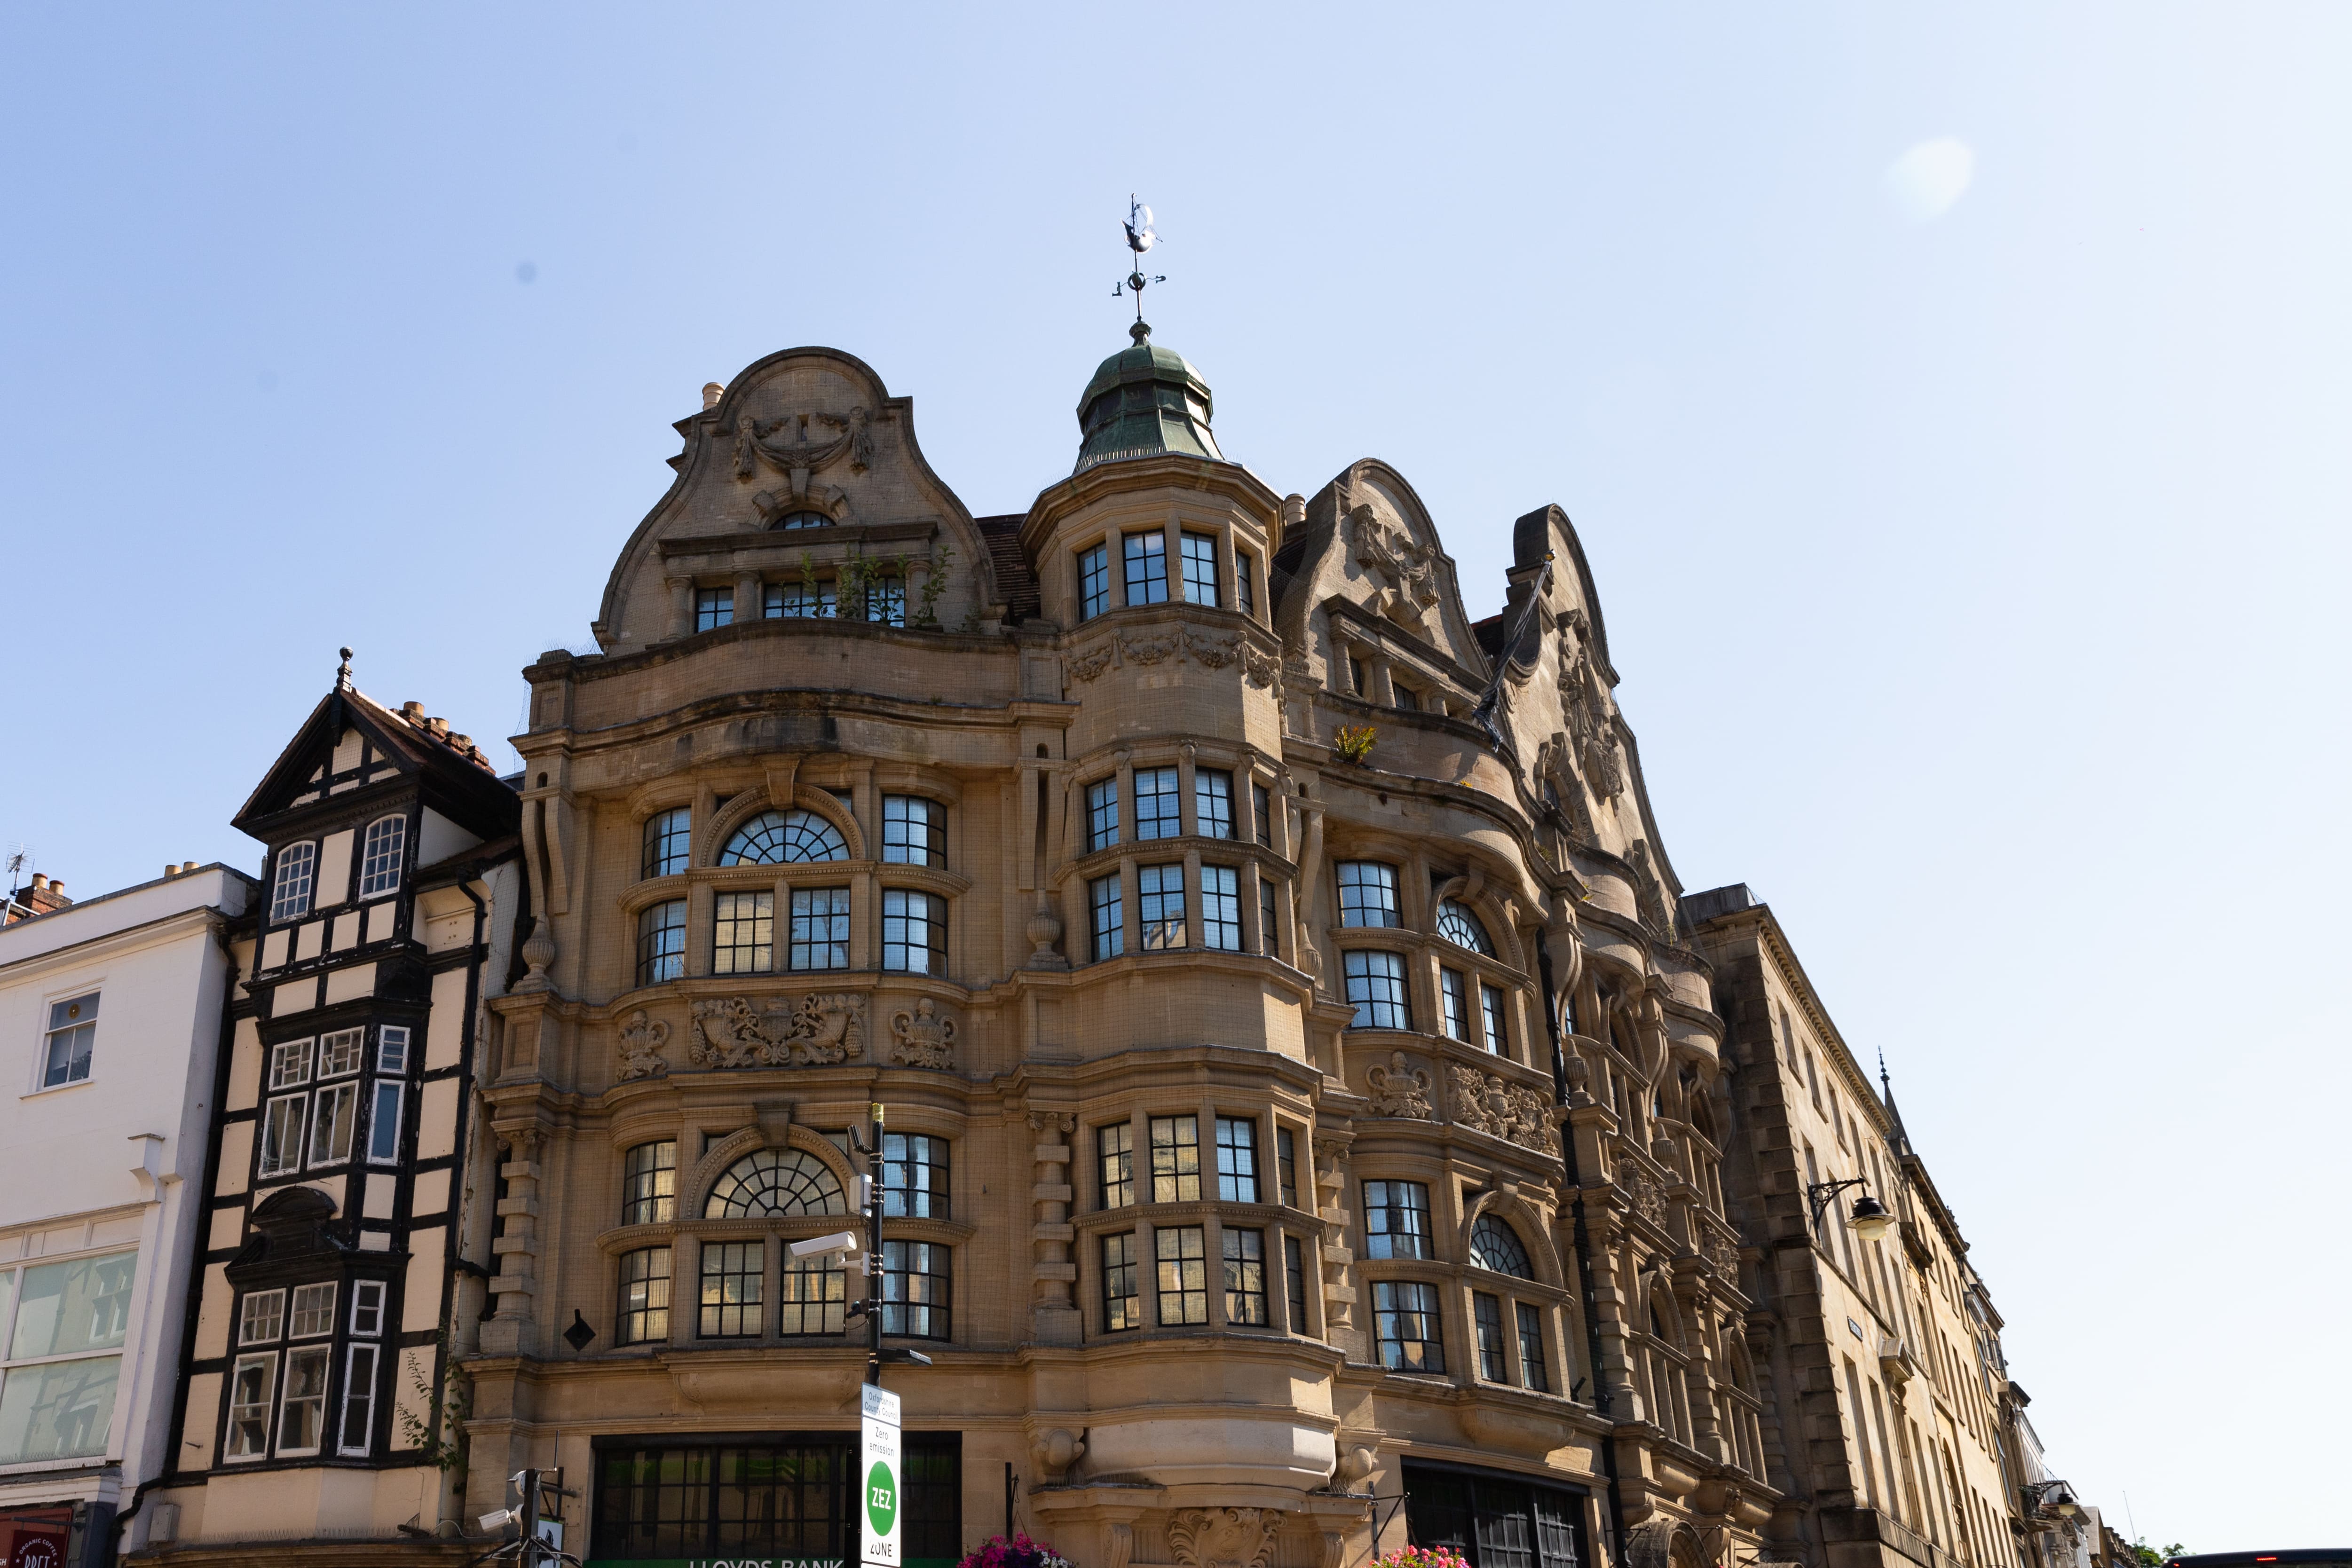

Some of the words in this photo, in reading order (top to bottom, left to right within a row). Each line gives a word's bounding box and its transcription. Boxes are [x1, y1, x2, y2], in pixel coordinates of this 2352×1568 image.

[869, 1392, 894, 1408] Oxfordshire
[865, 1402, 880, 1416] County
[882, 1408, 899, 1420] Council
[876, 1426, 888, 1441] Zero
[869, 1442, 894, 1457] emission
[872, 1487, 891, 1510] ZEZ
[19, 1538, 41, 1555] ORGANIC
[42, 1539, 57, 1557] COFFEE
[870, 1542, 892, 1558] ZONE
